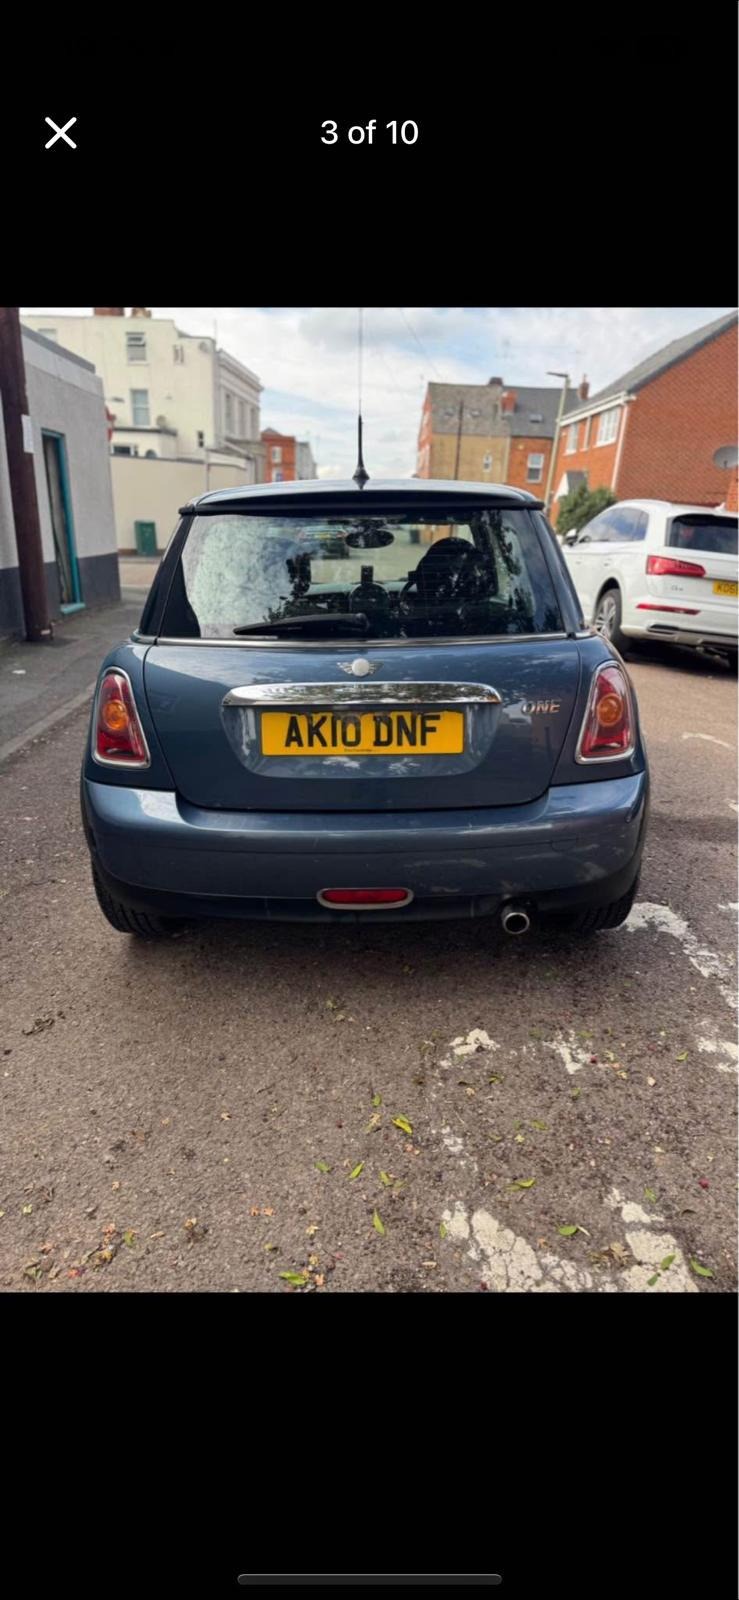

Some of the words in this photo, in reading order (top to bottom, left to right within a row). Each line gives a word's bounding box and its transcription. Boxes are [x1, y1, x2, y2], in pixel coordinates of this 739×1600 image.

[521, 699, 562, 715] ONE
[284, 713, 362, 747] AK10
[373, 713, 441, 747] DNF
